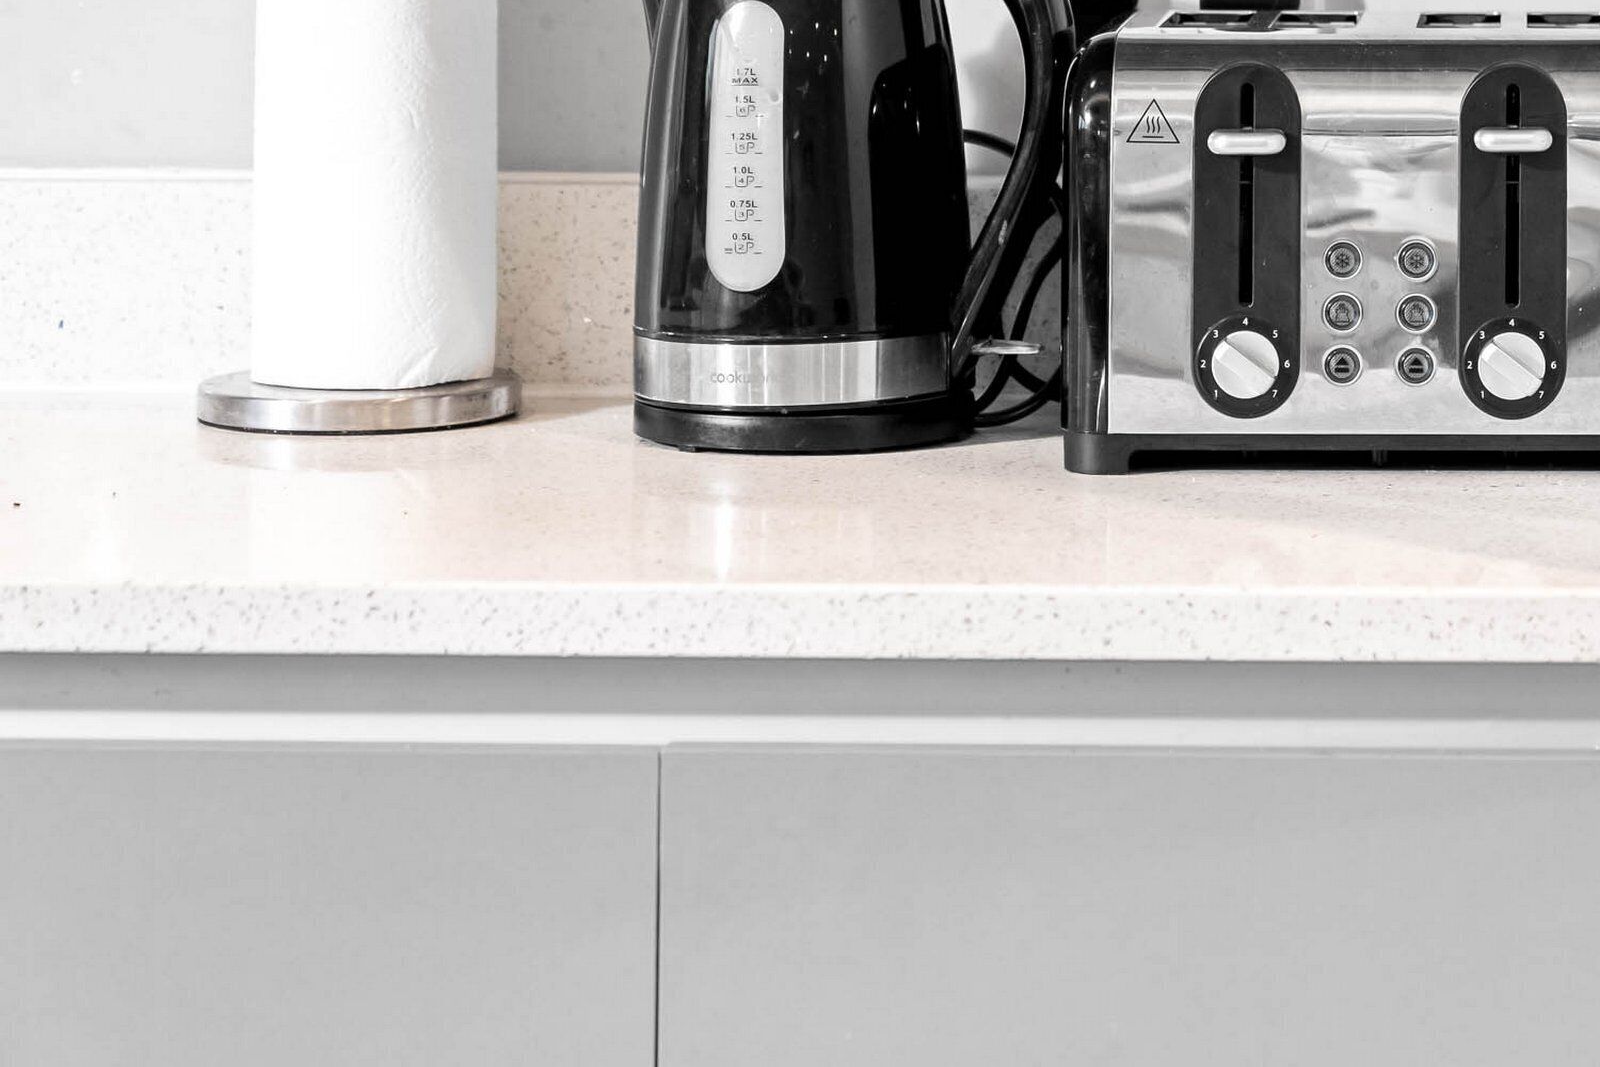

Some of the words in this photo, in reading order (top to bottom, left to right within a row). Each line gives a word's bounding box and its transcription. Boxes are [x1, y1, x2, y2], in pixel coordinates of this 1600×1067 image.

[735, 95, 756, 104] 1.5L
[731, 132, 758, 141] 1.25L
[733, 166, 754, 174] 1.0L
[730, 199, 758, 208] 0.75L
[732, 232, 754, 241] 0.5L
[1242, 317, 1249, 326] 4
[1508, 318, 1516, 327] 4
[1213, 329, 1219, 339] 3
[1272, 329, 1279, 339] 5
[1479, 330, 1486, 340] 3
[1538, 330, 1545, 340] 5
[1200, 359, 1207, 369] 2
[1284, 359, 1291, 369] 6
[1467, 360, 1473, 370] 2
[1550, 360, 1558, 370] 6
[1214, 389, 1218, 400] 1
[1272, 389, 1278, 398] 7
[1480, 390, 1485, 400] 1
[1538, 390, 1544, 399] 7
